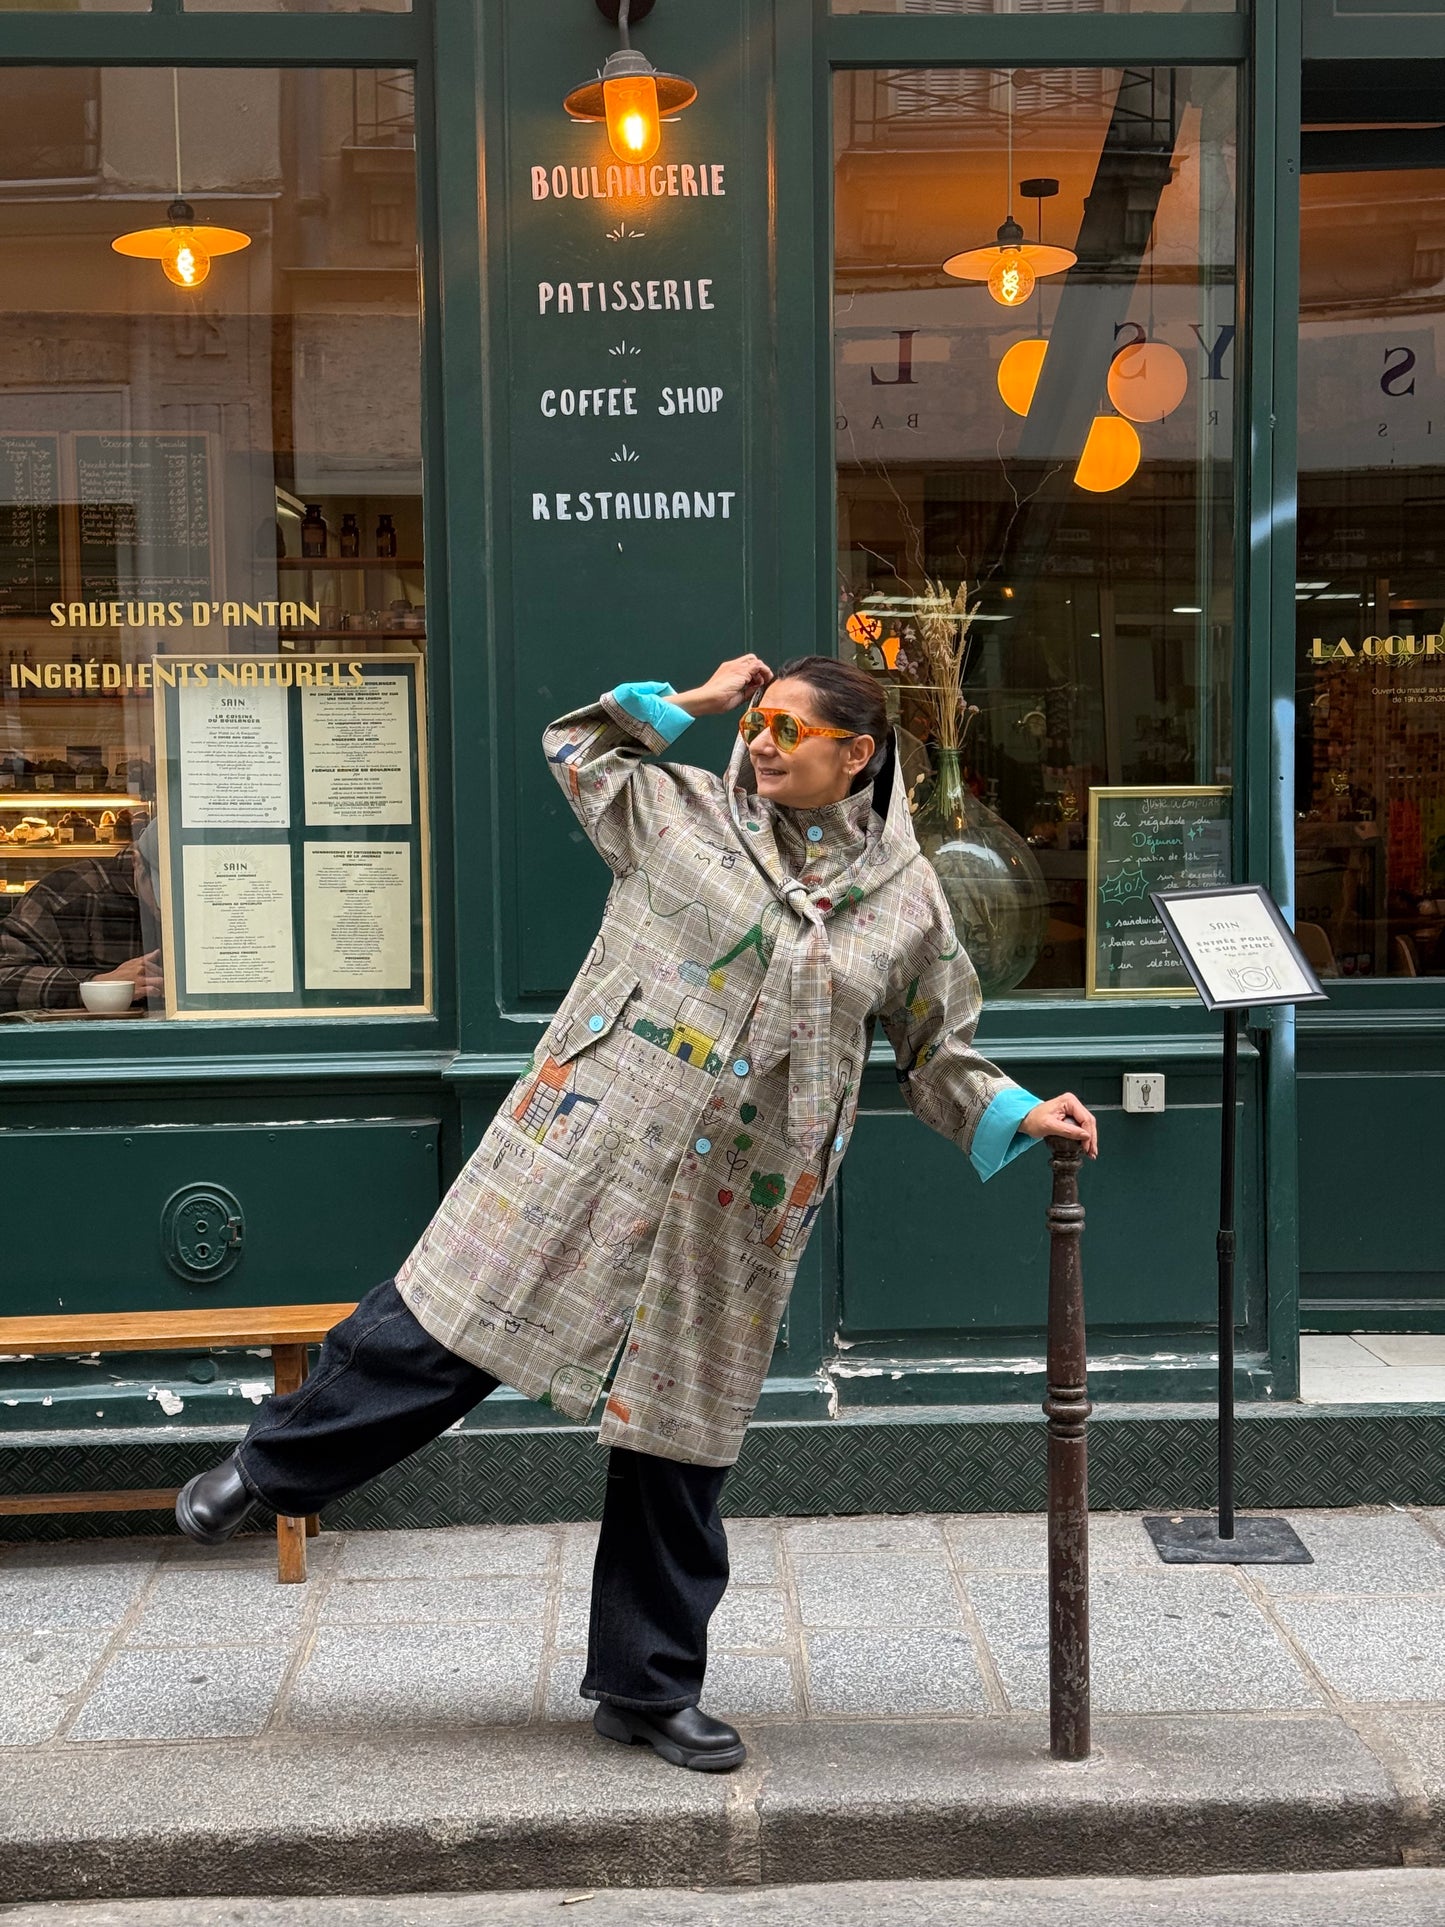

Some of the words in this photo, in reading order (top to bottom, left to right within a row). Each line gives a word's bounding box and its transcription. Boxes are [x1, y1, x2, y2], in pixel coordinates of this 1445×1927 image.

[530, 164, 726, 200] BOULANGERIE
[538, 278, 715, 314] PATISSERIE
[540, 387, 638, 418] COFFEE
[658, 387, 724, 416] SHOP
[50, 602, 183, 627] SAVEURS
[192, 601, 320, 627] D'ANTAN
[1312, 637, 1355, 658] LA
[10, 658, 208, 689] INGRÉDIENTS
[217, 662, 364, 688] NATURELS
[1408, 686, 1426, 694] mardi
[1113, 812, 1130, 827] La
[1138, 816, 1185, 833] régalade
[1192, 816, 1210, 824] du
[1132, 832, 1183, 854] Déjeuner
[1169, 853, 1178, 861] de
[1183, 852, 1200, 860] 12h
[1164, 881, 1180, 890] de
[1209, 922, 1240, 931] SAIN
[1196, 938, 1236, 946] ENTRÉE
[1241, 942, 1275, 950] PLACE
